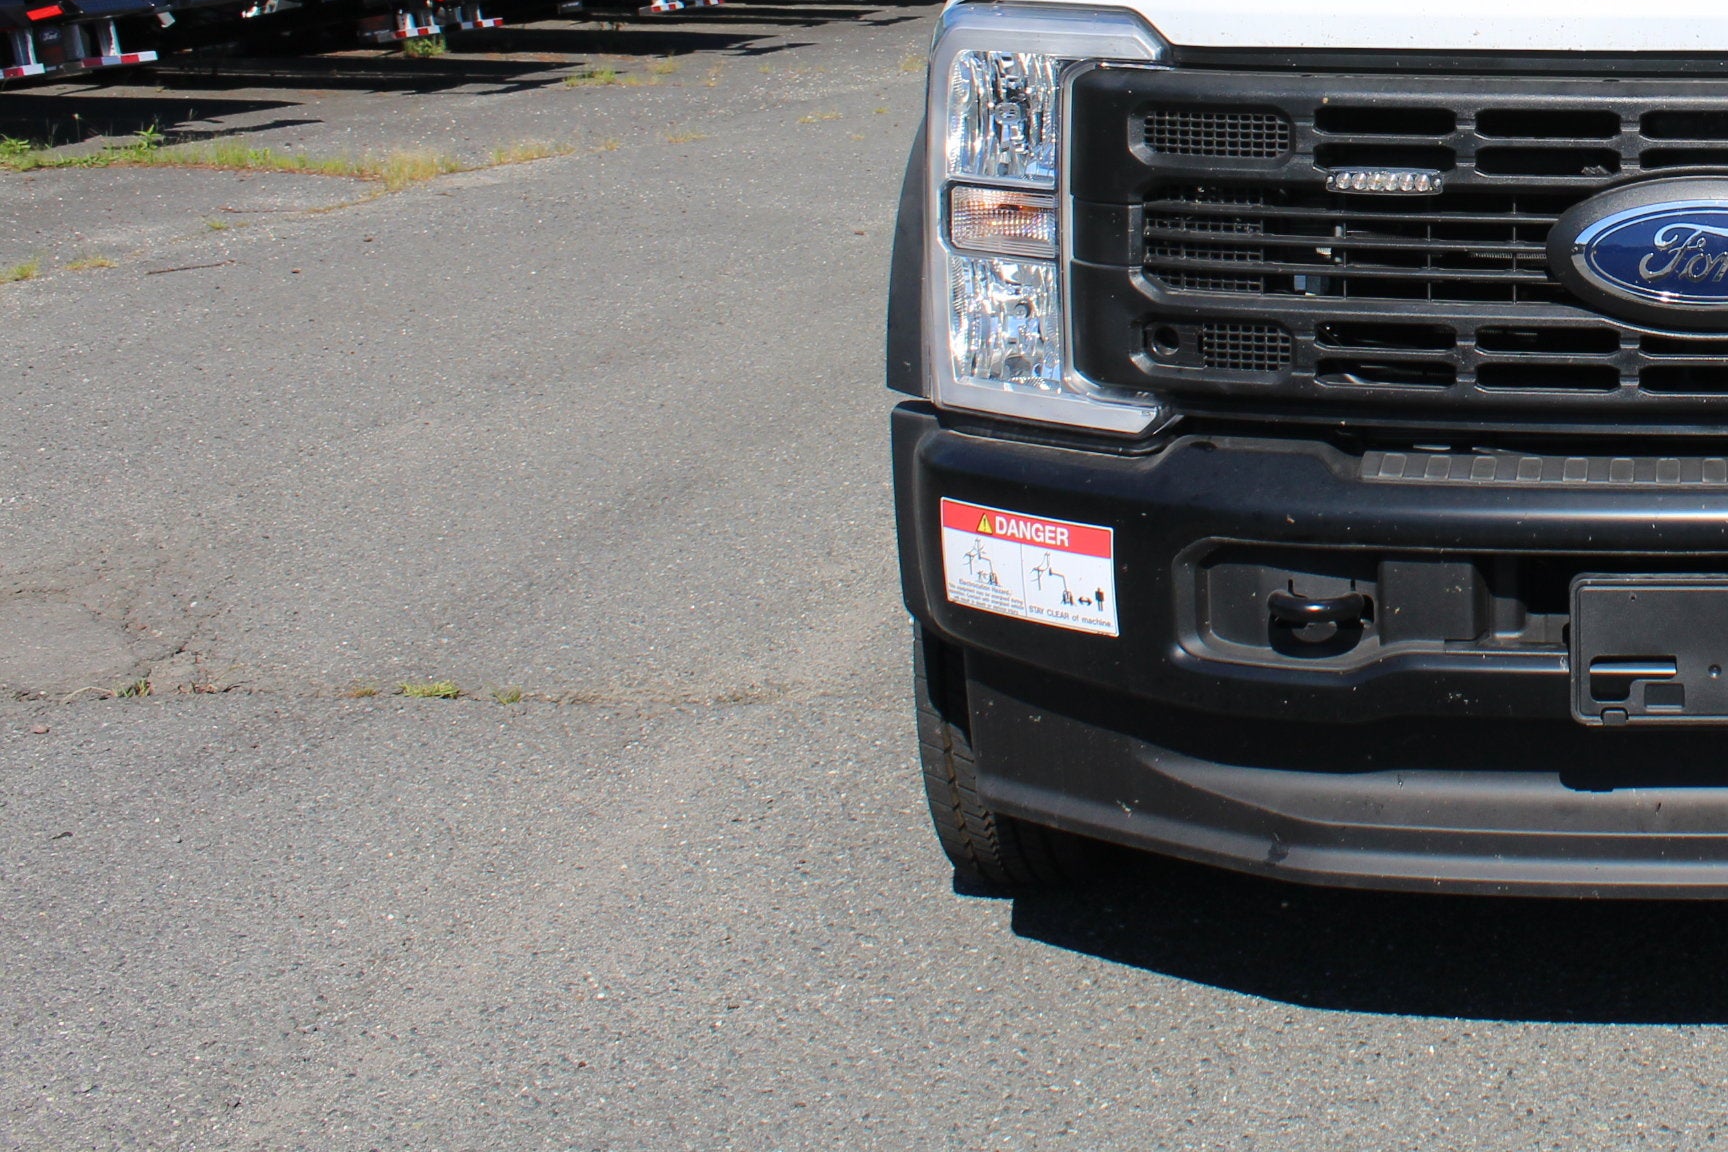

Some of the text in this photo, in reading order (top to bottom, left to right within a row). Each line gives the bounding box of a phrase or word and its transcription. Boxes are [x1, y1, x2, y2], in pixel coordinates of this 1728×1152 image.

[995, 516, 1069, 547] DANGER
[1029, 605, 1044, 616] STAY
[1047, 608, 1069, 620] CLEAR
[1072, 613, 1080, 622] of
